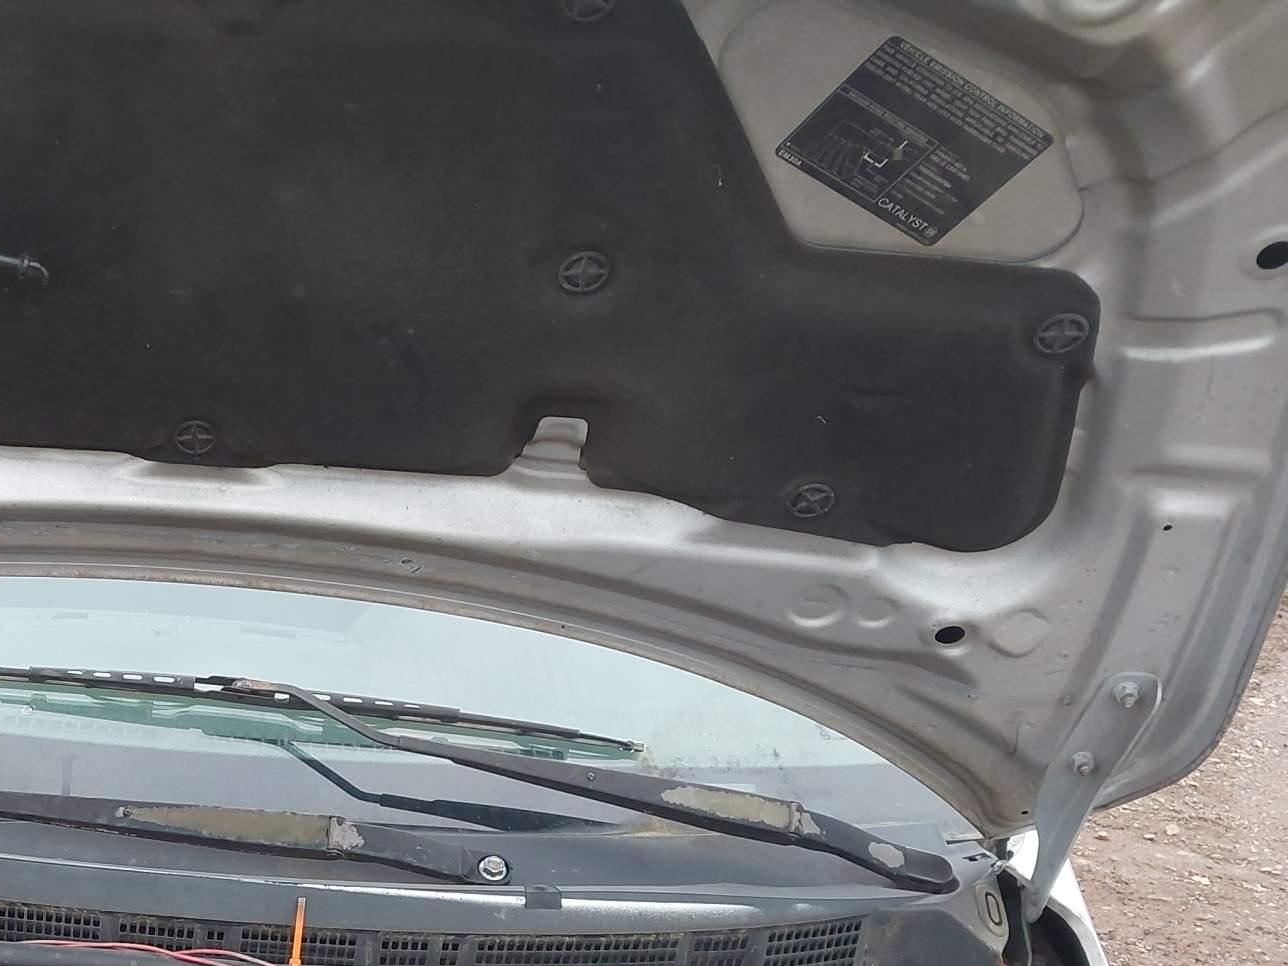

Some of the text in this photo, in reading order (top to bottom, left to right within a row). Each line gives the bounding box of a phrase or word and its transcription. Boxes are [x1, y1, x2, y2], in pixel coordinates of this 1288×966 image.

[900, 41, 1046, 139] VEHICLE EMISSION CONTROL INFORMATION
[878, 197, 929, 231] CATALYST
